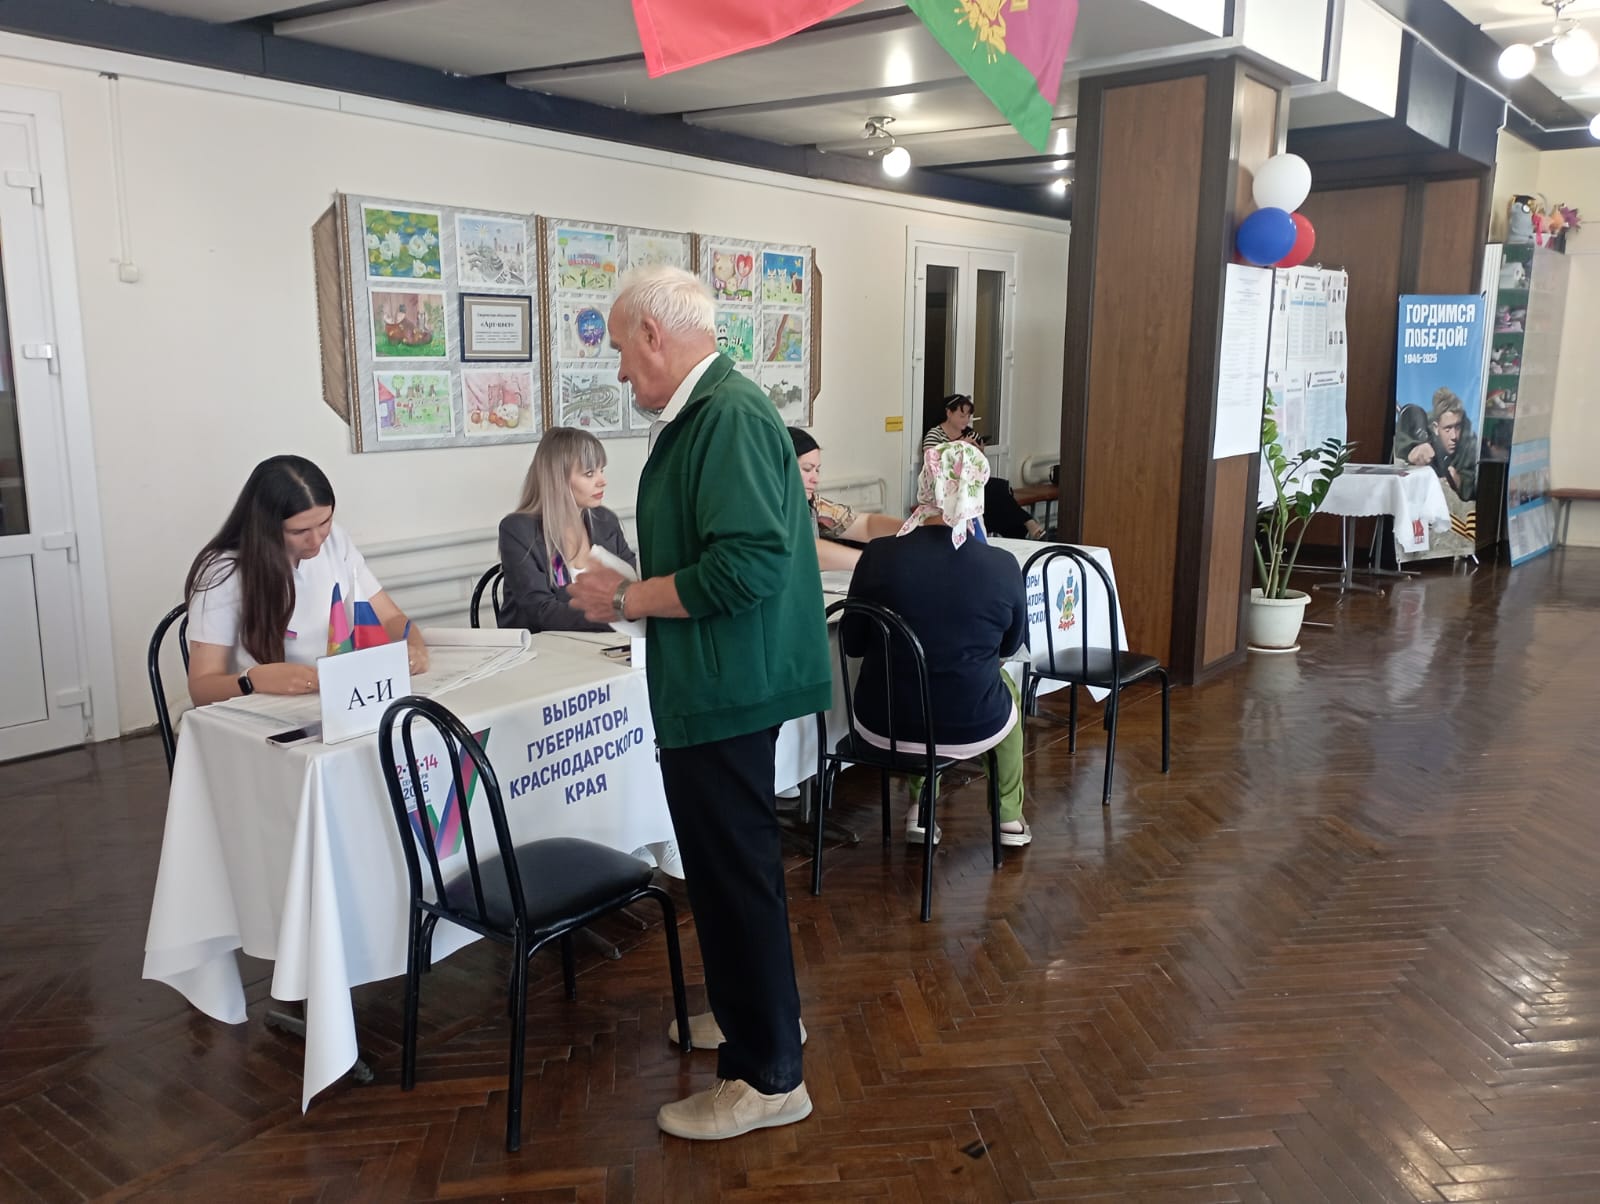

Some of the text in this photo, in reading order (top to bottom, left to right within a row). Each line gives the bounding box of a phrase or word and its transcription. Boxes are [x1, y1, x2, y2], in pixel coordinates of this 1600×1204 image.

[1406, 303, 1476, 327] ГОРДИМСЯ
[1404, 325, 1468, 350] ПОБЕДОЙ!
[347, 677, 394, 710] А-И
[542, 684, 611, 726] ВЫБОРЫ
[527, 706, 629, 763] ГУБЕРНАТОРА
[509, 727, 644, 800] КРАСНОДАРСКОГО
[403, 780, 430, 800] 205
[564, 773, 608, 805] КРАЯ
